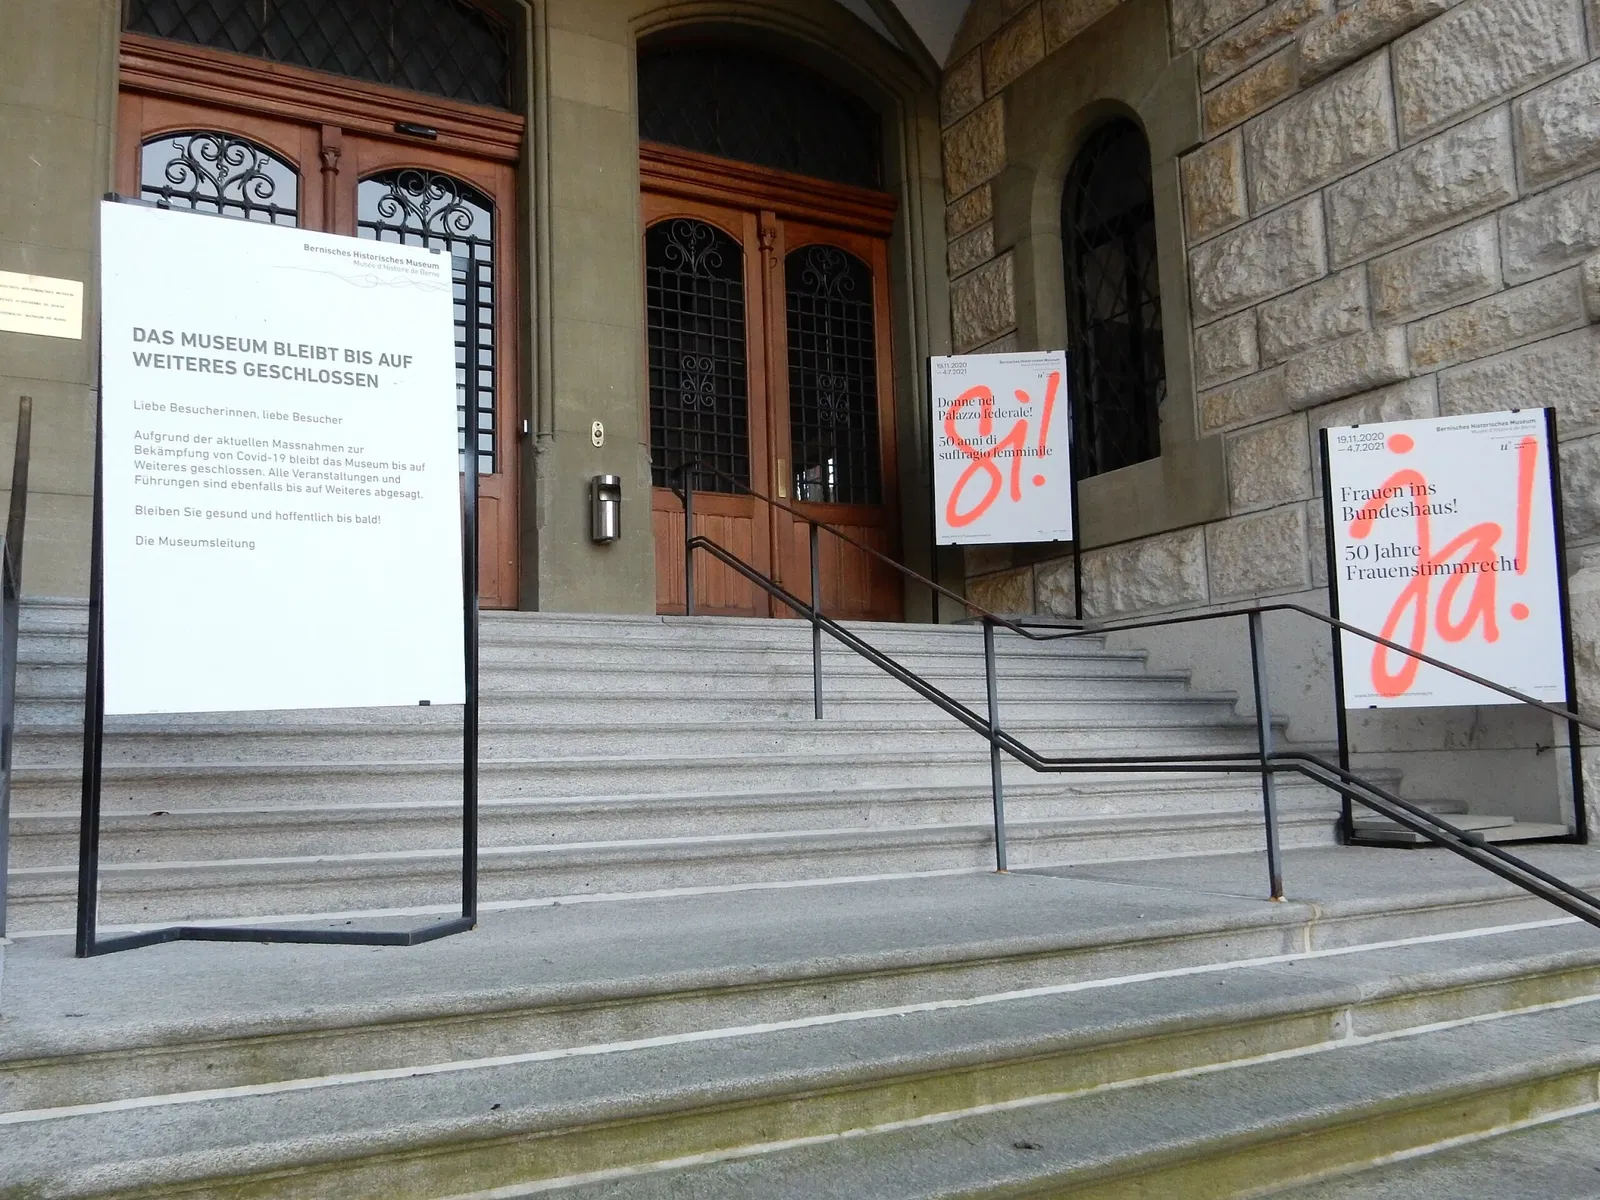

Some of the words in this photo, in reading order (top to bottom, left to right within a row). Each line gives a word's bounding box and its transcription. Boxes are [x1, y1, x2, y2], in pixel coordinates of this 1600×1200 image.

[304, 244, 351, 257] Bernisches
[353, 251, 403, 265] Historisches
[406, 259, 439, 269] Museum
[354, 260, 375, 268] Musée
[420, 269, 439, 277] Berne
[133, 327, 174, 345] DAS
[181, 332, 268, 355] MUSEUM
[274, 342, 338, 361] BLEIBT
[344, 349, 372, 364] BIS
[379, 353, 412, 369] AUF
[133, 352, 237, 375] WEITERES
[243, 362, 379, 388] GESCHLOSSEN
[938, 397, 975, 408] Donne
[979, 395, 995, 406] nel
[133, 400, 166, 413] Liebe
[170, 403, 260, 420] Besucherinnen,
[263, 410, 289, 421] liebe
[292, 411, 343, 425] Besucher
[938, 409, 981, 420] Palazzo
[983, 407, 1033, 418] federale!
[1337, 432, 1384, 443] 19.11.2020
[1436, 424, 1469, 432] Bernisches
[134, 430, 190, 444] Aufgrund
[193, 433, 213, 444] der
[216, 435, 269, 448] aktuellen
[272, 439, 345, 453] Massnahmen
[347, 445, 364, 454] zur
[939, 436, 955, 447] 50
[957, 435, 983, 446] anni
[986, 435, 997, 445] di
[134, 445, 209, 461] Bekämpfung
[213, 451, 233, 460] von
[237, 451, 286, 464] Covid-19
[289, 455, 320, 466] bleibt
[323, 456, 342, 467] das
[345, 458, 389, 470] Museum
[392, 460, 407, 470] bis
[410, 462, 426, 472] auf
[939, 448, 991, 461] suffragio
[993, 446, 1052, 458] femminile
[134, 460, 187, 473] Weiteres
[190, 463, 266, 477] geschlossen.
[268, 467, 290, 477] Alle
[292, 469, 379, 485] Veranstaltungen
[382, 474, 401, 484] und
[134, 474, 200, 489] Führungen
[203, 479, 228, 489] sind
[231, 480, 283, 492] ebenfalls
[286, 482, 302, 493] bis
[306, 483, 323, 494] auf
[325, 485, 371, 496] Weiteres
[374, 487, 424, 501] abgesagt.
[1340, 484, 1404, 502] Frauen
[1409, 482, 1436, 497] ins
[135, 506, 181, 517] Bleiben
[184, 507, 202, 518] Sie
[205, 509, 248, 521] gesund
[251, 510, 272, 520] und
[275, 511, 333, 523] hoffentlich
[336, 513, 352, 524] bis
[355, 514, 381, 525] bald!
[1342, 499, 1458, 522] Bundeshaus!
[135, 536, 155, 546] Die
[158, 536, 256, 550] Museumsleitung
[1345, 544, 1369, 561] 50
[1373, 543, 1422, 563] Jahre
[1346, 556, 1521, 581] Frauenstimmrecht
